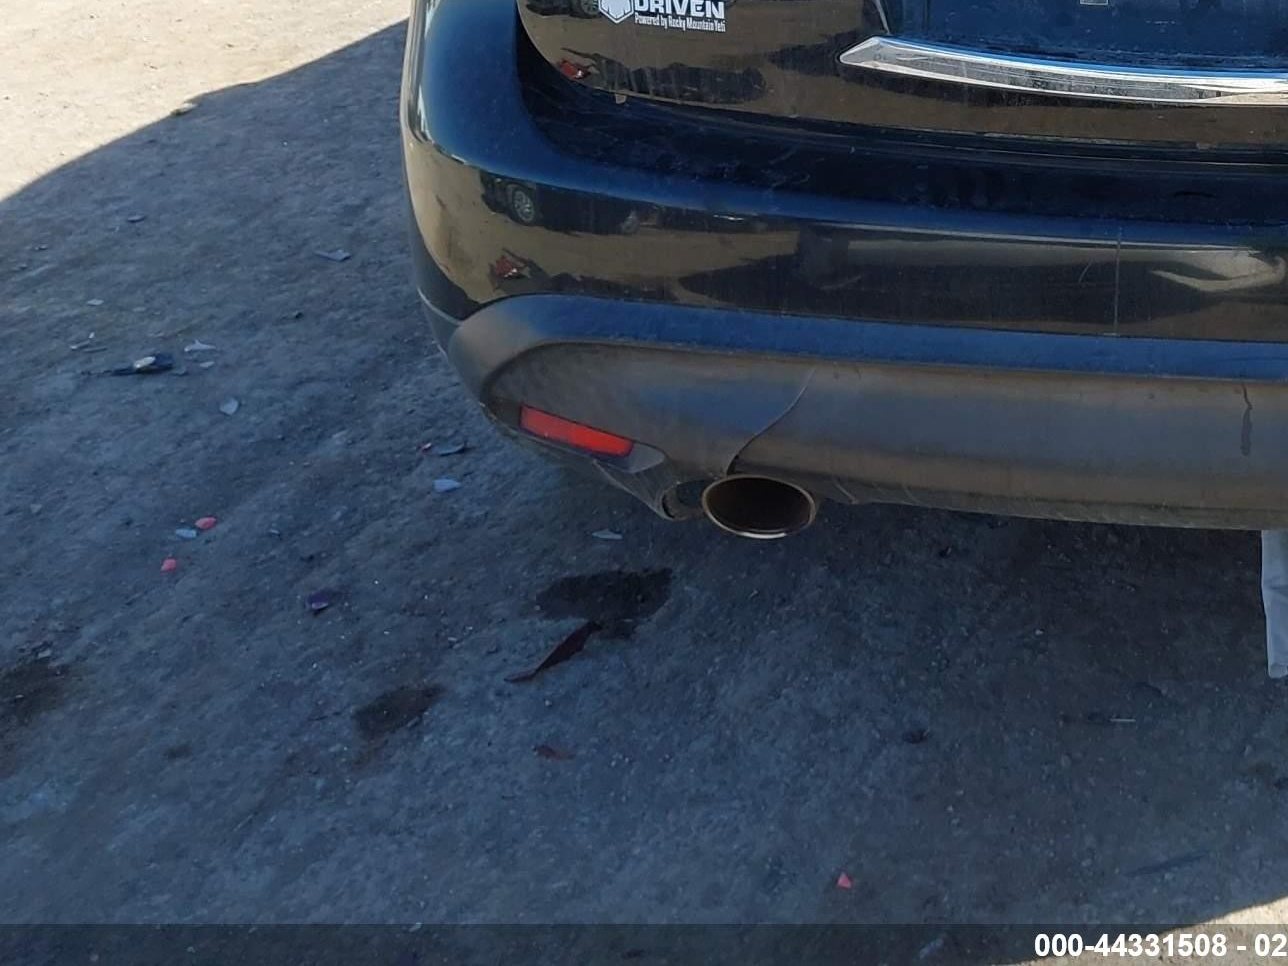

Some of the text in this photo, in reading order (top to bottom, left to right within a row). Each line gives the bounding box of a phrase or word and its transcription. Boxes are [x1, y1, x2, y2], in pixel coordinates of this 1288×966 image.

[634, 12, 726, 33] Powered by Rocky Mountain Yeti
